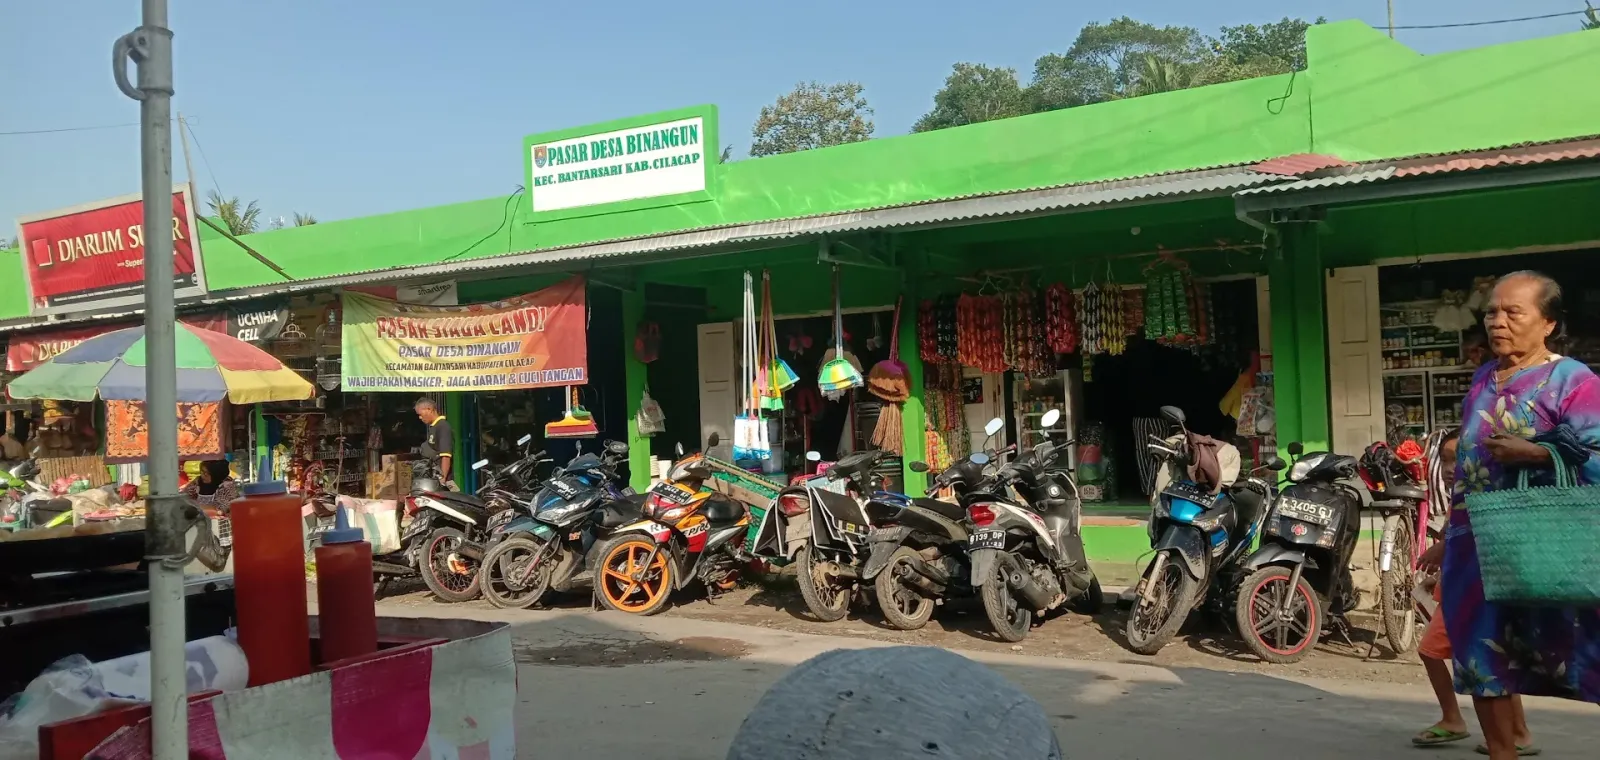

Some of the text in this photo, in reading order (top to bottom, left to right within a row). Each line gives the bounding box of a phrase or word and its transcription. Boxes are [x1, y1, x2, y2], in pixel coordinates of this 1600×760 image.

[548, 124, 698, 166] PASAR DESA BINANGUN
[534, 152, 700, 186] KEC. BANTARSARI KAB. CILACAP
[58, 217, 184, 262] DJARUM SUR
[238, 312, 278, 327] UCHIHA
[376, 316, 428, 339] PASAR
[432, 316, 486, 338] SIAGA
[238, 329, 260, 342] CELL
[398, 340, 522, 358] PASAR DESA BINANGUN
[386, 358, 536, 371] KECAMATAN BANTARSARI KABUPATEN CILACAP
[348, 376, 376, 388] WAJIB
[376, 376, 404, 388] PAKAI
[446, 375, 471, 388] JAGA
[508, 374, 517, 385] &
[518, 371, 540, 384] CUCI
[542, 368, 584, 383] TANGAN
[1291, 500, 1317, 514] 3405
